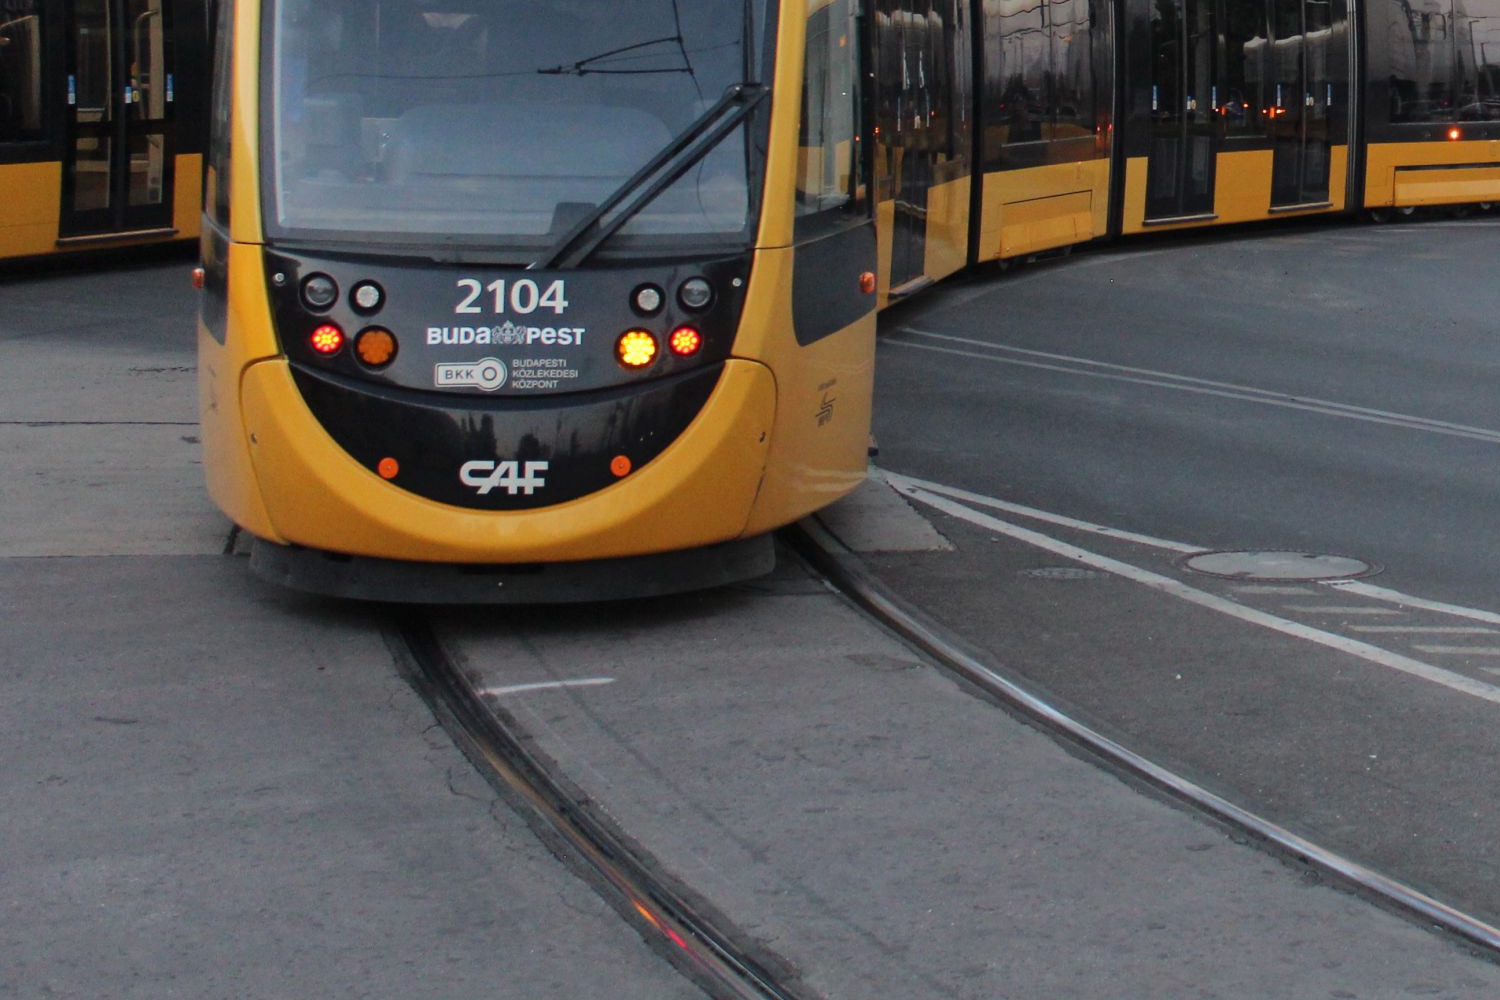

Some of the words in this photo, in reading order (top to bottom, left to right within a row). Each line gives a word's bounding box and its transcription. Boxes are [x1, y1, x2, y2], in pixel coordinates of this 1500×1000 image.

[455, 278, 569, 314] 2104
[512, 358, 567, 368] BUDAPESTI
[445, 369, 475, 380] BKK
[512, 378, 559, 389] KÖZPONT
[459, 460, 549, 495] CAF
